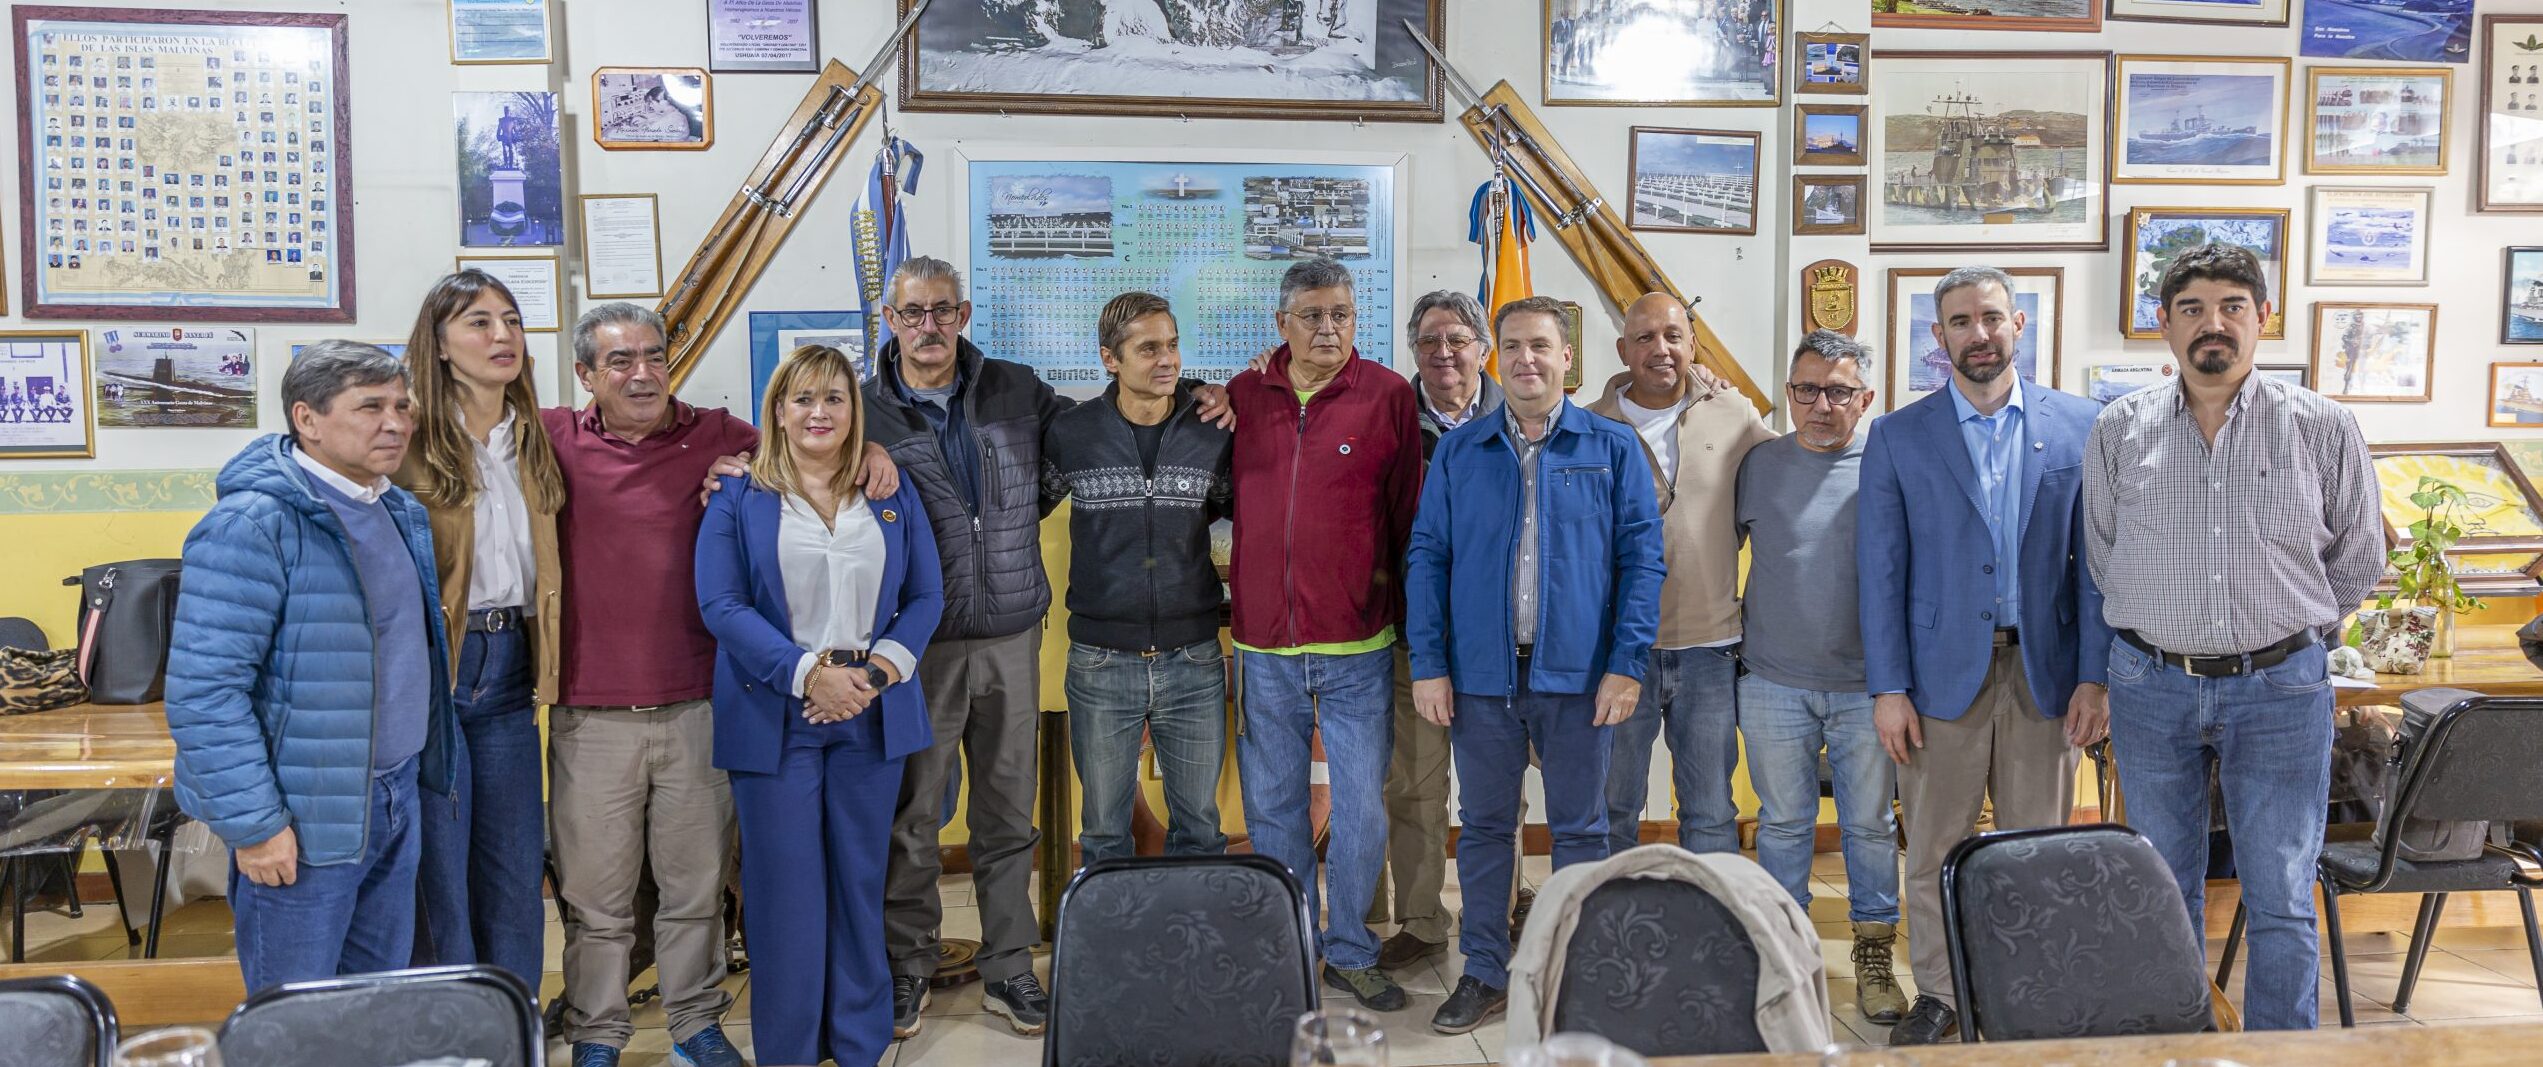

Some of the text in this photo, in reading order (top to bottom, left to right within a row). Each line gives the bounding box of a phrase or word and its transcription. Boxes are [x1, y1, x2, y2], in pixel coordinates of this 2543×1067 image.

[63, 34, 97, 43] ELLOS
[102, 35, 180, 44] PARTICIPARON
[185, 37, 199, 45] EN
[200, 38, 216, 46] LA
[81, 44, 214, 54] DE LAS ISLAS MALVINAS
